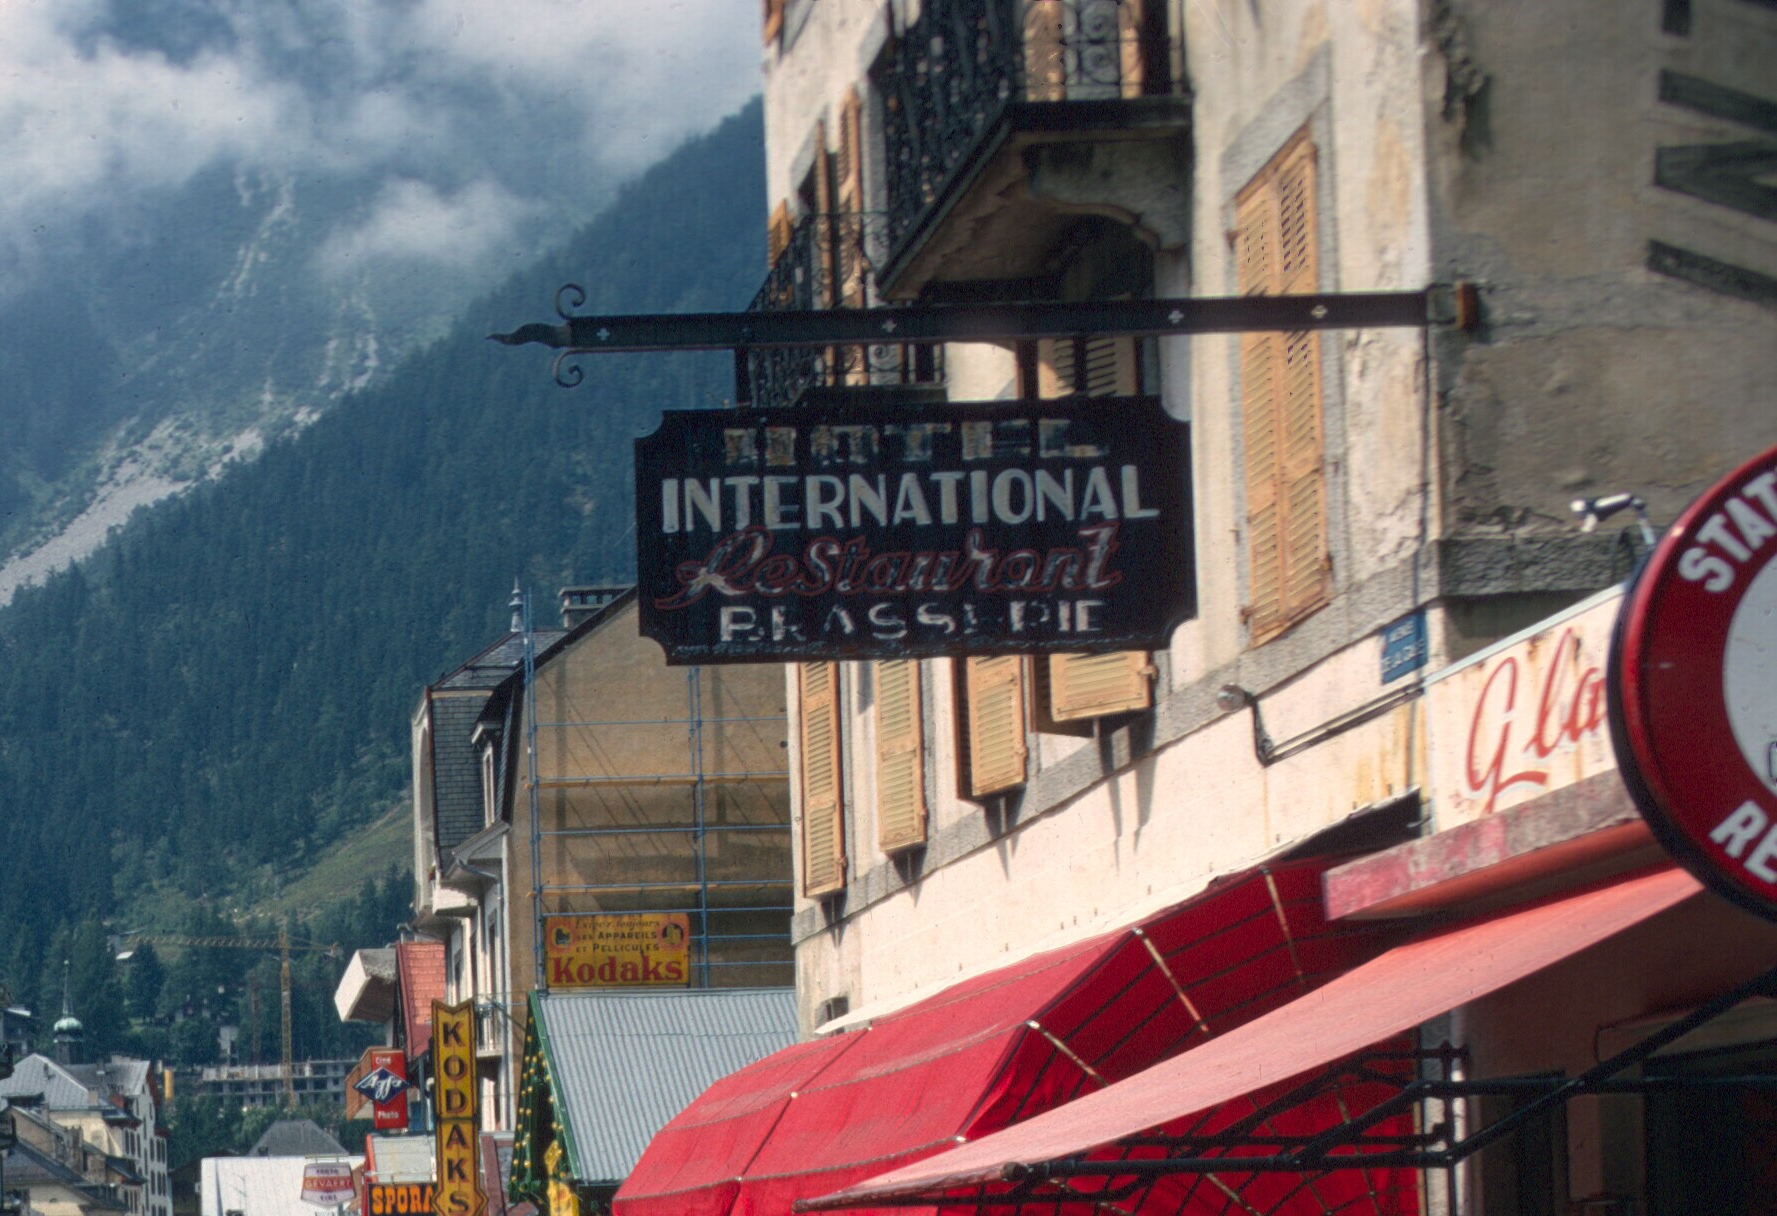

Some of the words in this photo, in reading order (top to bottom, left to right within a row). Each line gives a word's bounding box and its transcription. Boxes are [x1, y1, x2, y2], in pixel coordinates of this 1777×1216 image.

[661, 464, 1162, 534] INTERNATIONAL
[550, 955, 684, 984] Kodaks
[360, 1075, 403, 1100] Agfa
[442, 1021, 471, 1216] KODAKS
[304, 1179, 353, 1188] GEVAERT
